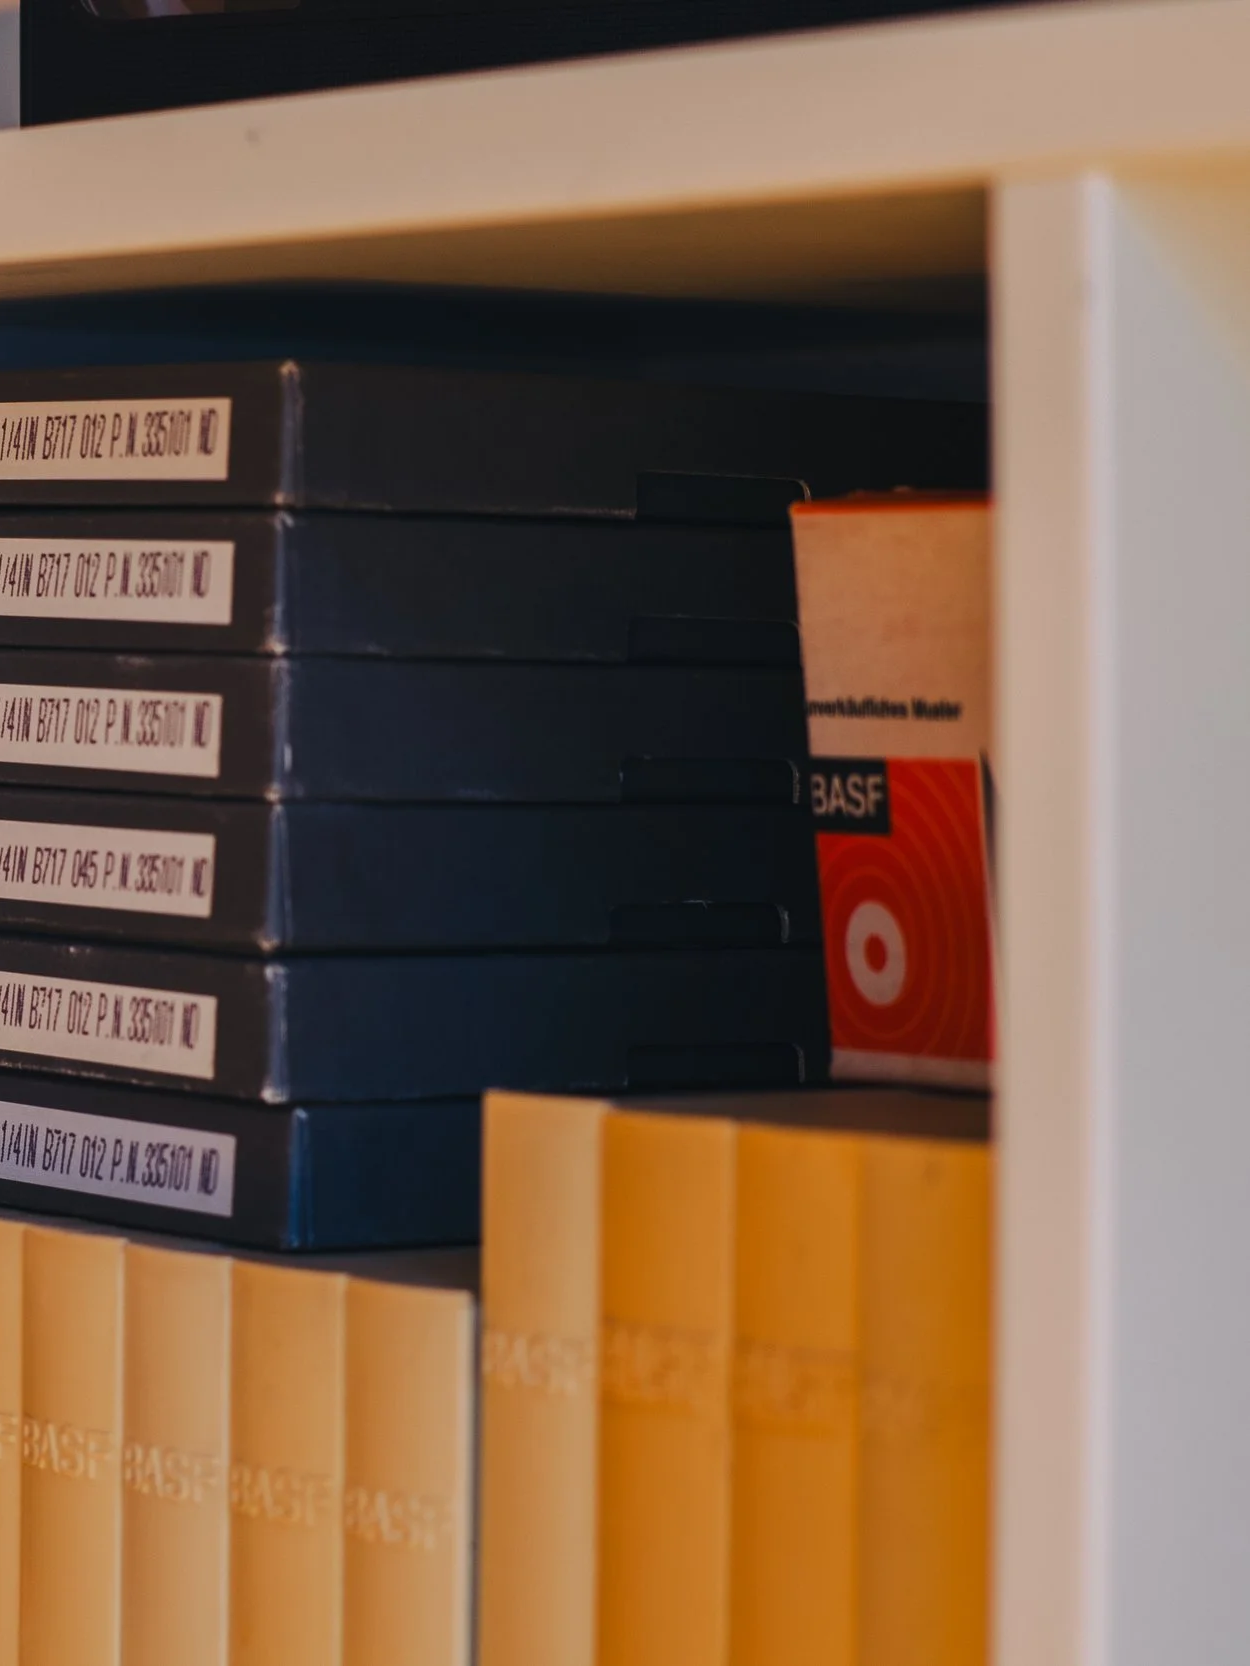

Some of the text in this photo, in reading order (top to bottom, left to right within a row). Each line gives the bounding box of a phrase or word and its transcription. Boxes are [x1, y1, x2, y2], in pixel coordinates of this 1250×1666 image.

[1, 416, 39, 460] 1/4IN
[43, 415, 77, 460] B717
[80, 414, 106, 459] 012
[37, 553, 71, 598] B717
[75, 553, 101, 598] 012
[37, 698, 70, 743] B717
[75, 698, 100, 744] 012
[806, 695, 962, 720] nverkäufliches Muster
[810, 773, 884, 818] BASF
[33, 846, 66, 887] B717
[71, 849, 98, 888] 045
[29, 986, 62, 1032] B717
[67, 990, 91, 1036] 012
[1, 1119, 39, 1169] 1/4IN
[43, 1129, 76, 1176] B717
[80, 1135, 107, 1181] 012
[22, 1414, 114, 1480] BASF
[123, 1442, 223, 1503] BASF
